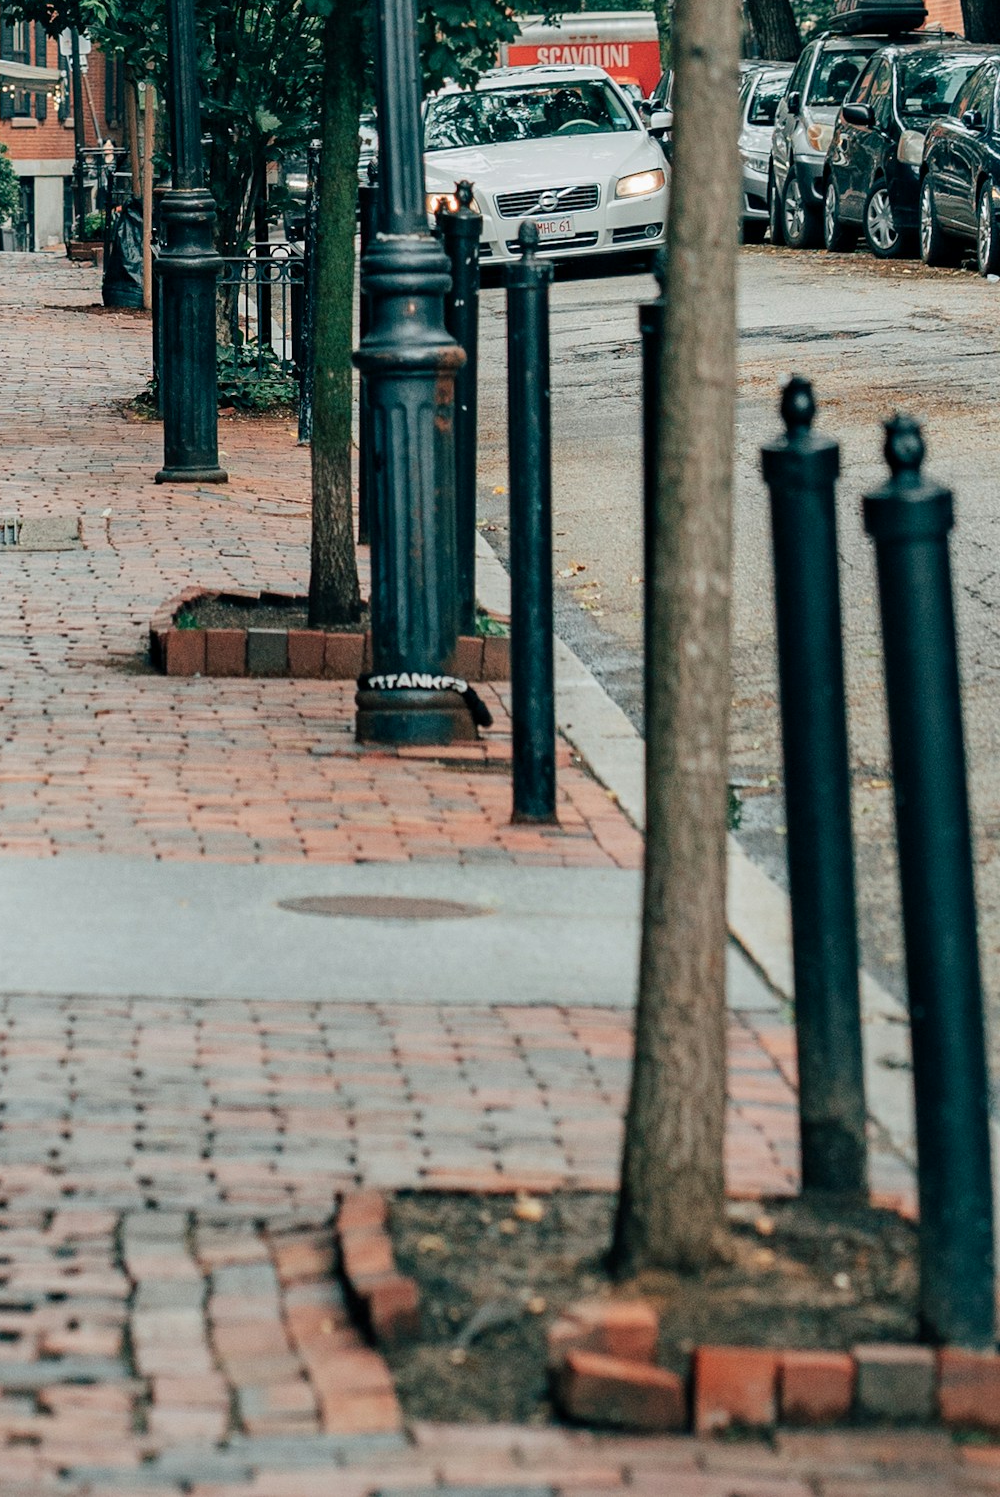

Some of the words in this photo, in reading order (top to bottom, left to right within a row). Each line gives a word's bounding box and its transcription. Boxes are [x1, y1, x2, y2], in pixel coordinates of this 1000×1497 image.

[537, 44, 630, 68] SCAVOLINI
[536, 221, 557, 234] MHC
[559, 220, 572, 232] 61
